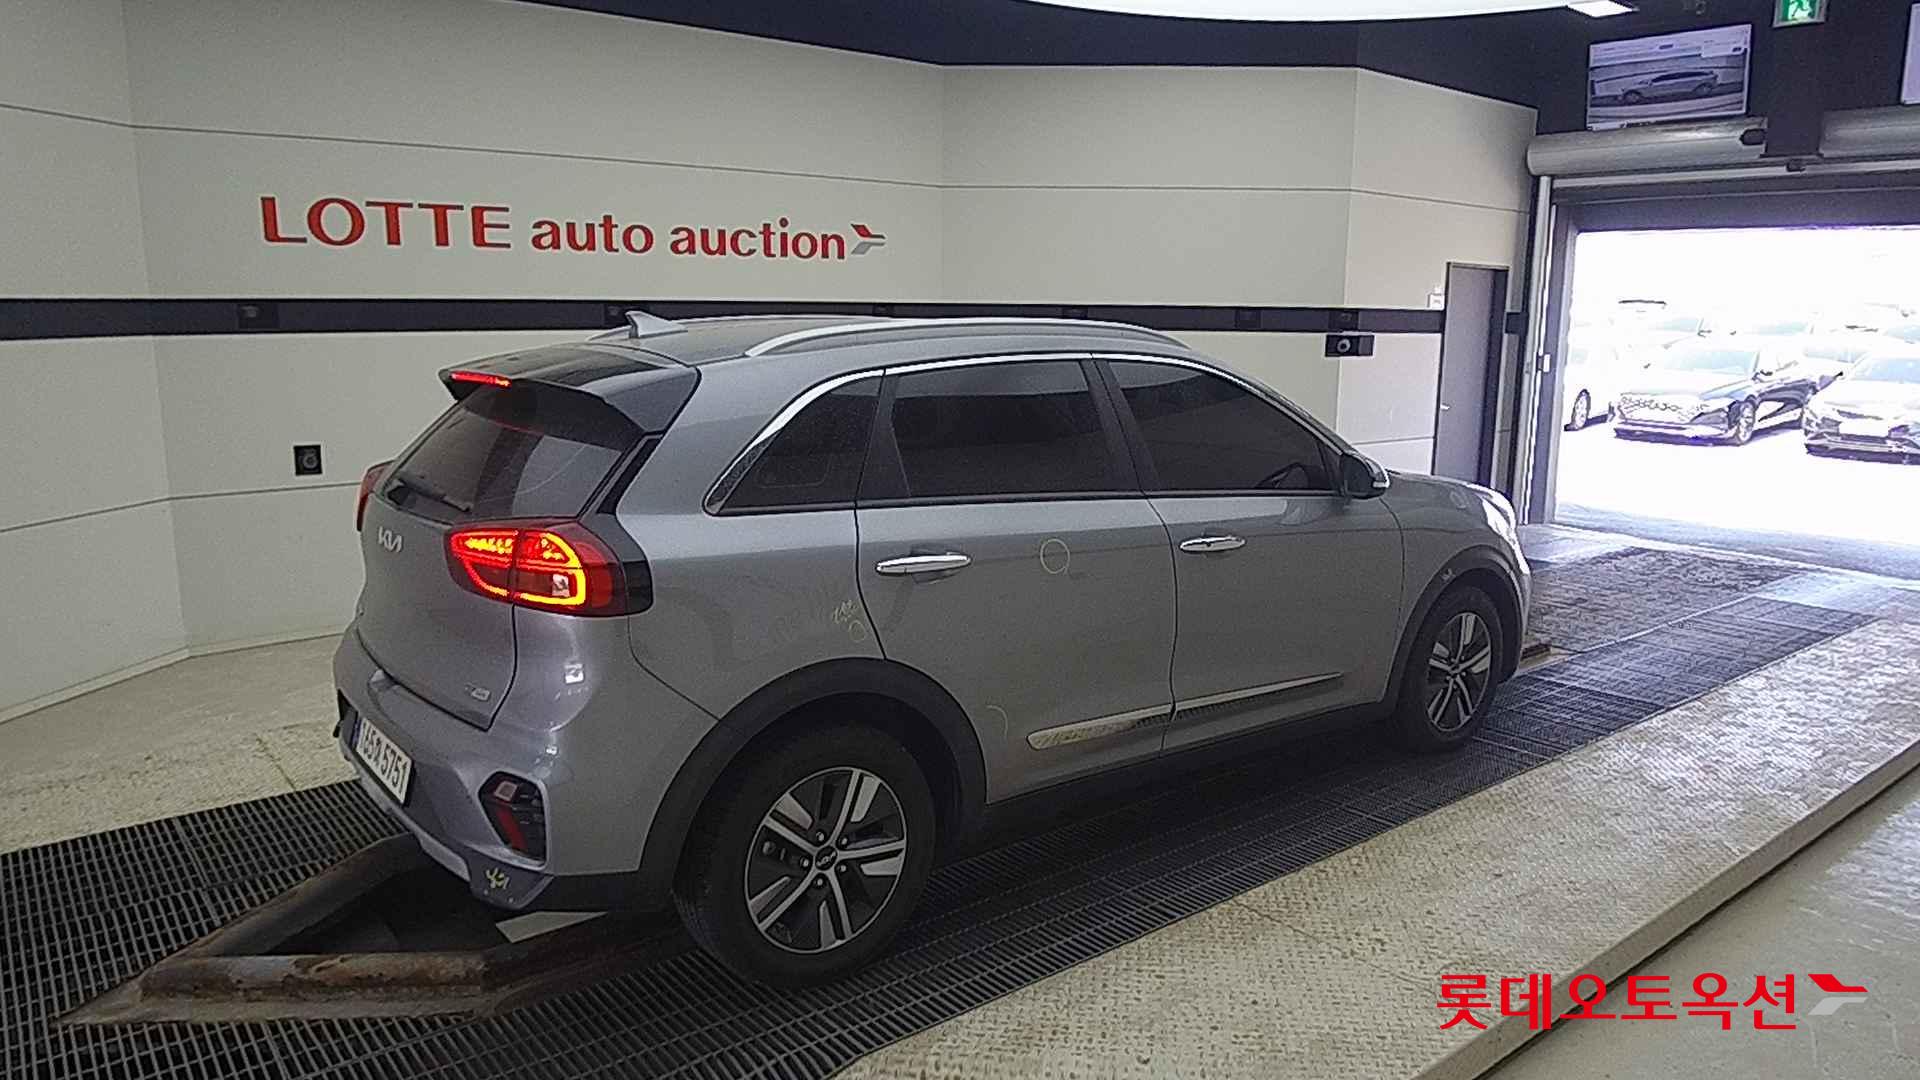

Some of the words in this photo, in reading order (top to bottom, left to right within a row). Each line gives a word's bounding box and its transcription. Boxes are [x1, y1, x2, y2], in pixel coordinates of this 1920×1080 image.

[260, 196, 511, 249] LOTTE
[531, 214, 655, 253] auto
[669, 217, 846, 259] auction
